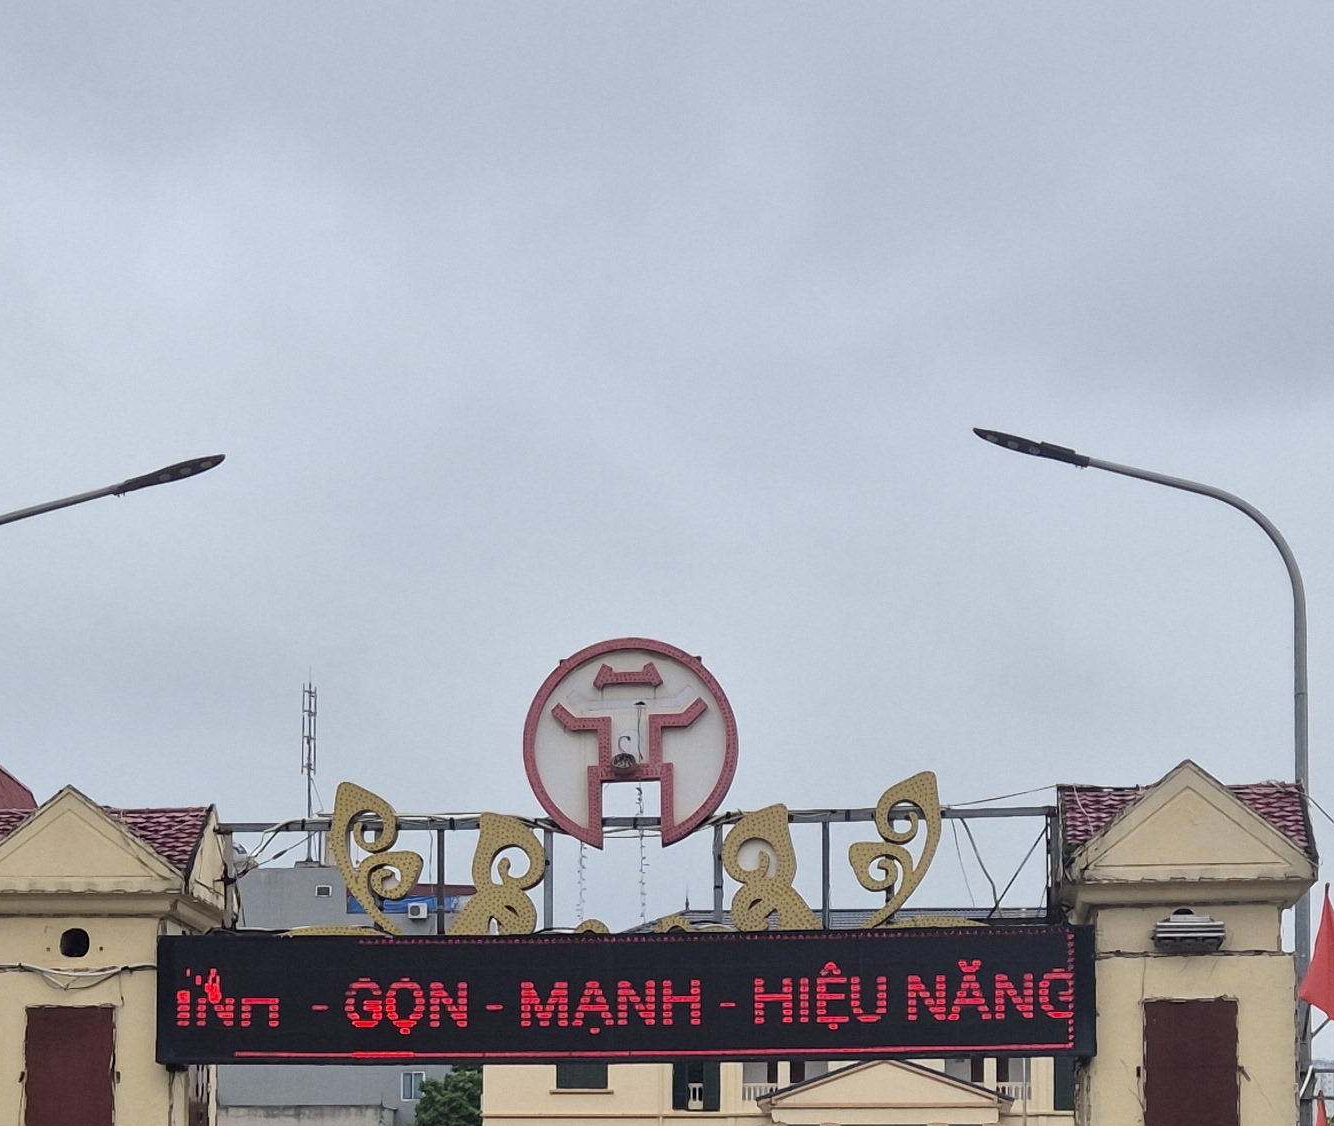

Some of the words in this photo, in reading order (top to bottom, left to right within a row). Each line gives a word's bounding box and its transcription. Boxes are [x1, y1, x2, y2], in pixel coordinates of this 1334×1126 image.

[344, 977, 468, 1035] GỌN
[520, 978, 702, 1035] MẠNH
[753, 961, 887, 1031] HIỆU
[906, 958, 1074, 1022] NĂNG
